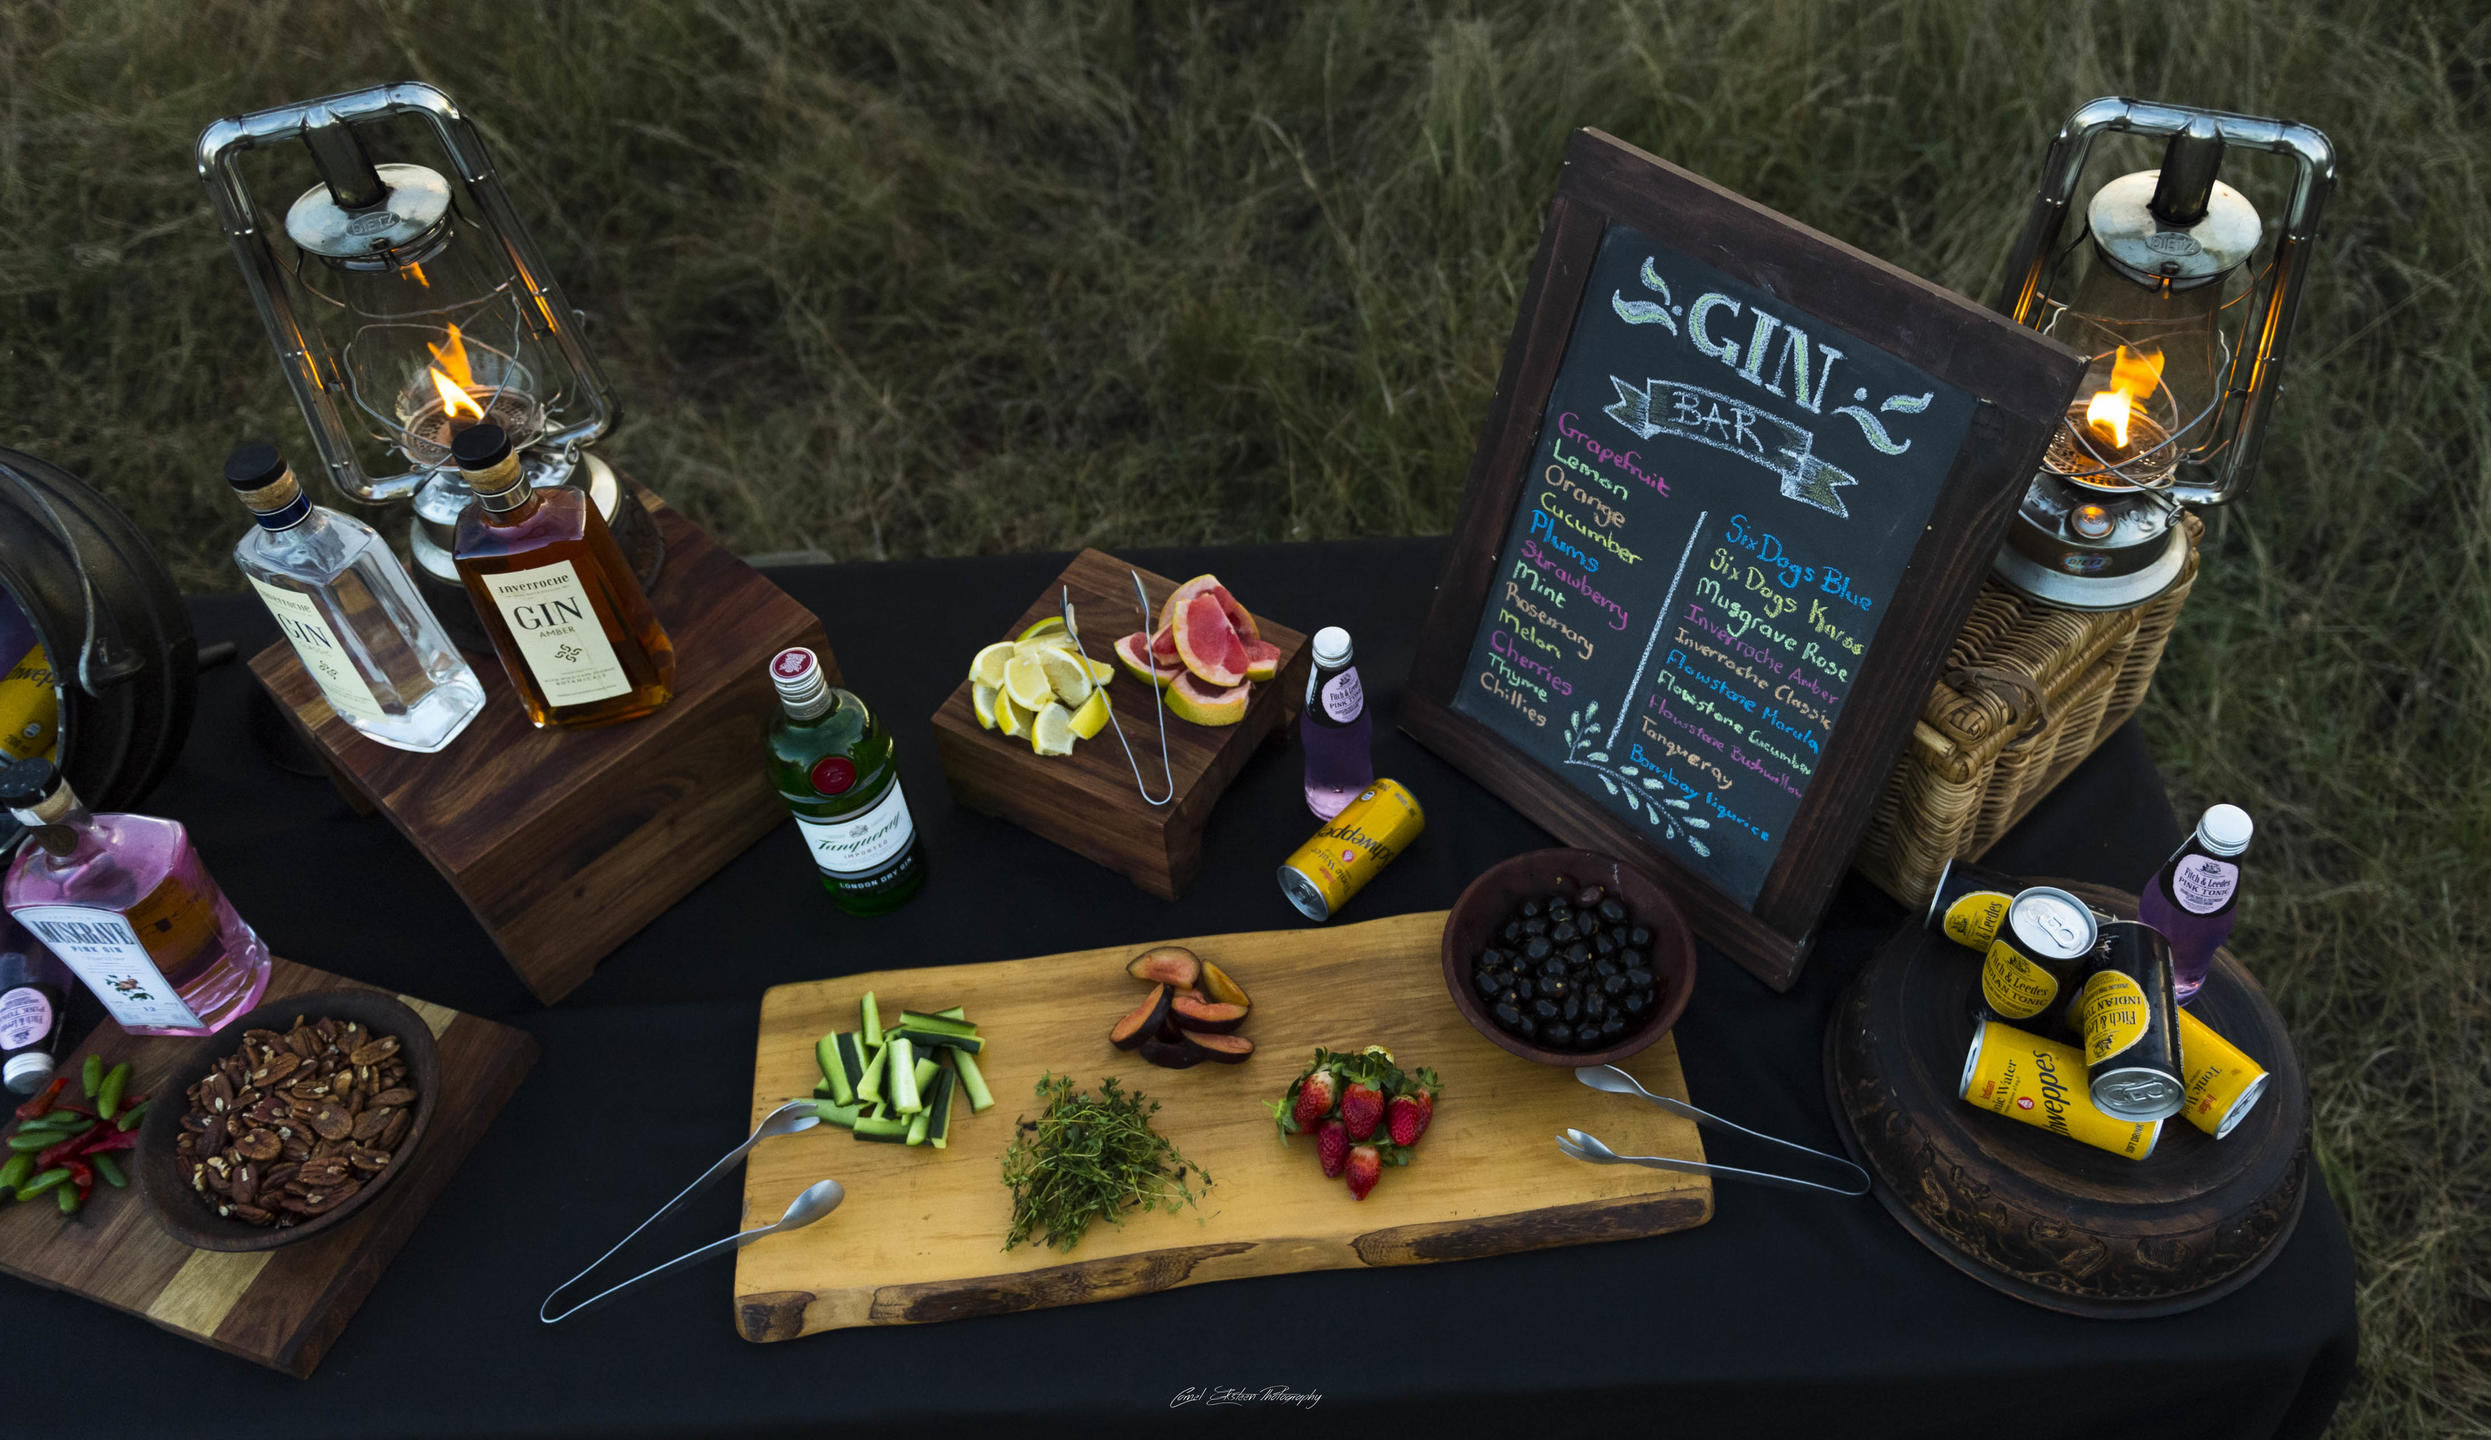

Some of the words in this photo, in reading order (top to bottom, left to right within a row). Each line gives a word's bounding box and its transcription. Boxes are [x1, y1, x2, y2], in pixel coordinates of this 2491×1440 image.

[1688, 292, 1848, 414] GIN
[1668, 391, 1765, 453] BAR
[1553, 438, 1630, 501] Lemon
[1558, 411, 1671, 498] Grapefruit
[1545, 464, 1625, 528] Orange
[1530, 509, 1599, 573] Plums
[1540, 491, 1643, 565] Cucumber
[1512, 560, 1566, 609] Mint
[1521, 539, 1629, 631] Strawberry
[1710, 548, 1741, 580] Six
[1745, 566, 1797, 618] Dogs
[1725, 513, 1758, 550] Six
[1756, 533, 1815, 589] Dogs
[1820, 566, 1872, 611] Blue
[278, 613, 333, 648] GIN
[513, 596, 583, 631] GIN
[540, 625, 576, 638] AMBER
[1499, 608, 1561, 659] Melon
[1505, 581, 1594, 660] Rosemary
[1696, 577, 1798, 651] Musgrave
[1802, 642, 1847, 683] Rose
[1488, 652, 1548, 703] Thyme
[1491, 630, 1573, 696] Cherries
[1675, 627, 1769, 689] Inverroche
[1775, 685, 1831, 730] Classic
[1683, 604, 1784, 674] Inverroche
[1788, 668, 1839, 704] Amber
[1480, 672, 1548, 727] Chillies
[1649, 694, 1725, 752] Flowstone
[1657, 669, 1744, 734] Flowstone
[1748, 730, 1811, 775] Cucumber
[1666, 649, 1757, 712] Flowstone
[1762, 707, 1819, 754] Marula
[1630, 743, 1700, 800] Bombay
[1642, 715, 1733, 790] Tanqueray
[818, 811, 900, 852] Tanqueray
[840, 880, 878, 889] LONDON
[880, 870, 898, 883] DRY
[2179, 876, 2198, 892] PINK
[2185, 867, 2200, 883] Fitch
[32, 921, 137, 945] MUSGRAVE
[1978, 901, 2003, 933] Leedes
[2005, 972, 2012, 982] &
[2013, 978, 2048, 996] Leedes
[2097, 996, 2141, 1010] INDIAN
[2101, 1016, 2107, 1029] &
[2110, 1011, 2136, 1026] Fitch
[1997, 1059, 2016, 1095] Water
[2192, 1066, 2222, 1095] Tonic
